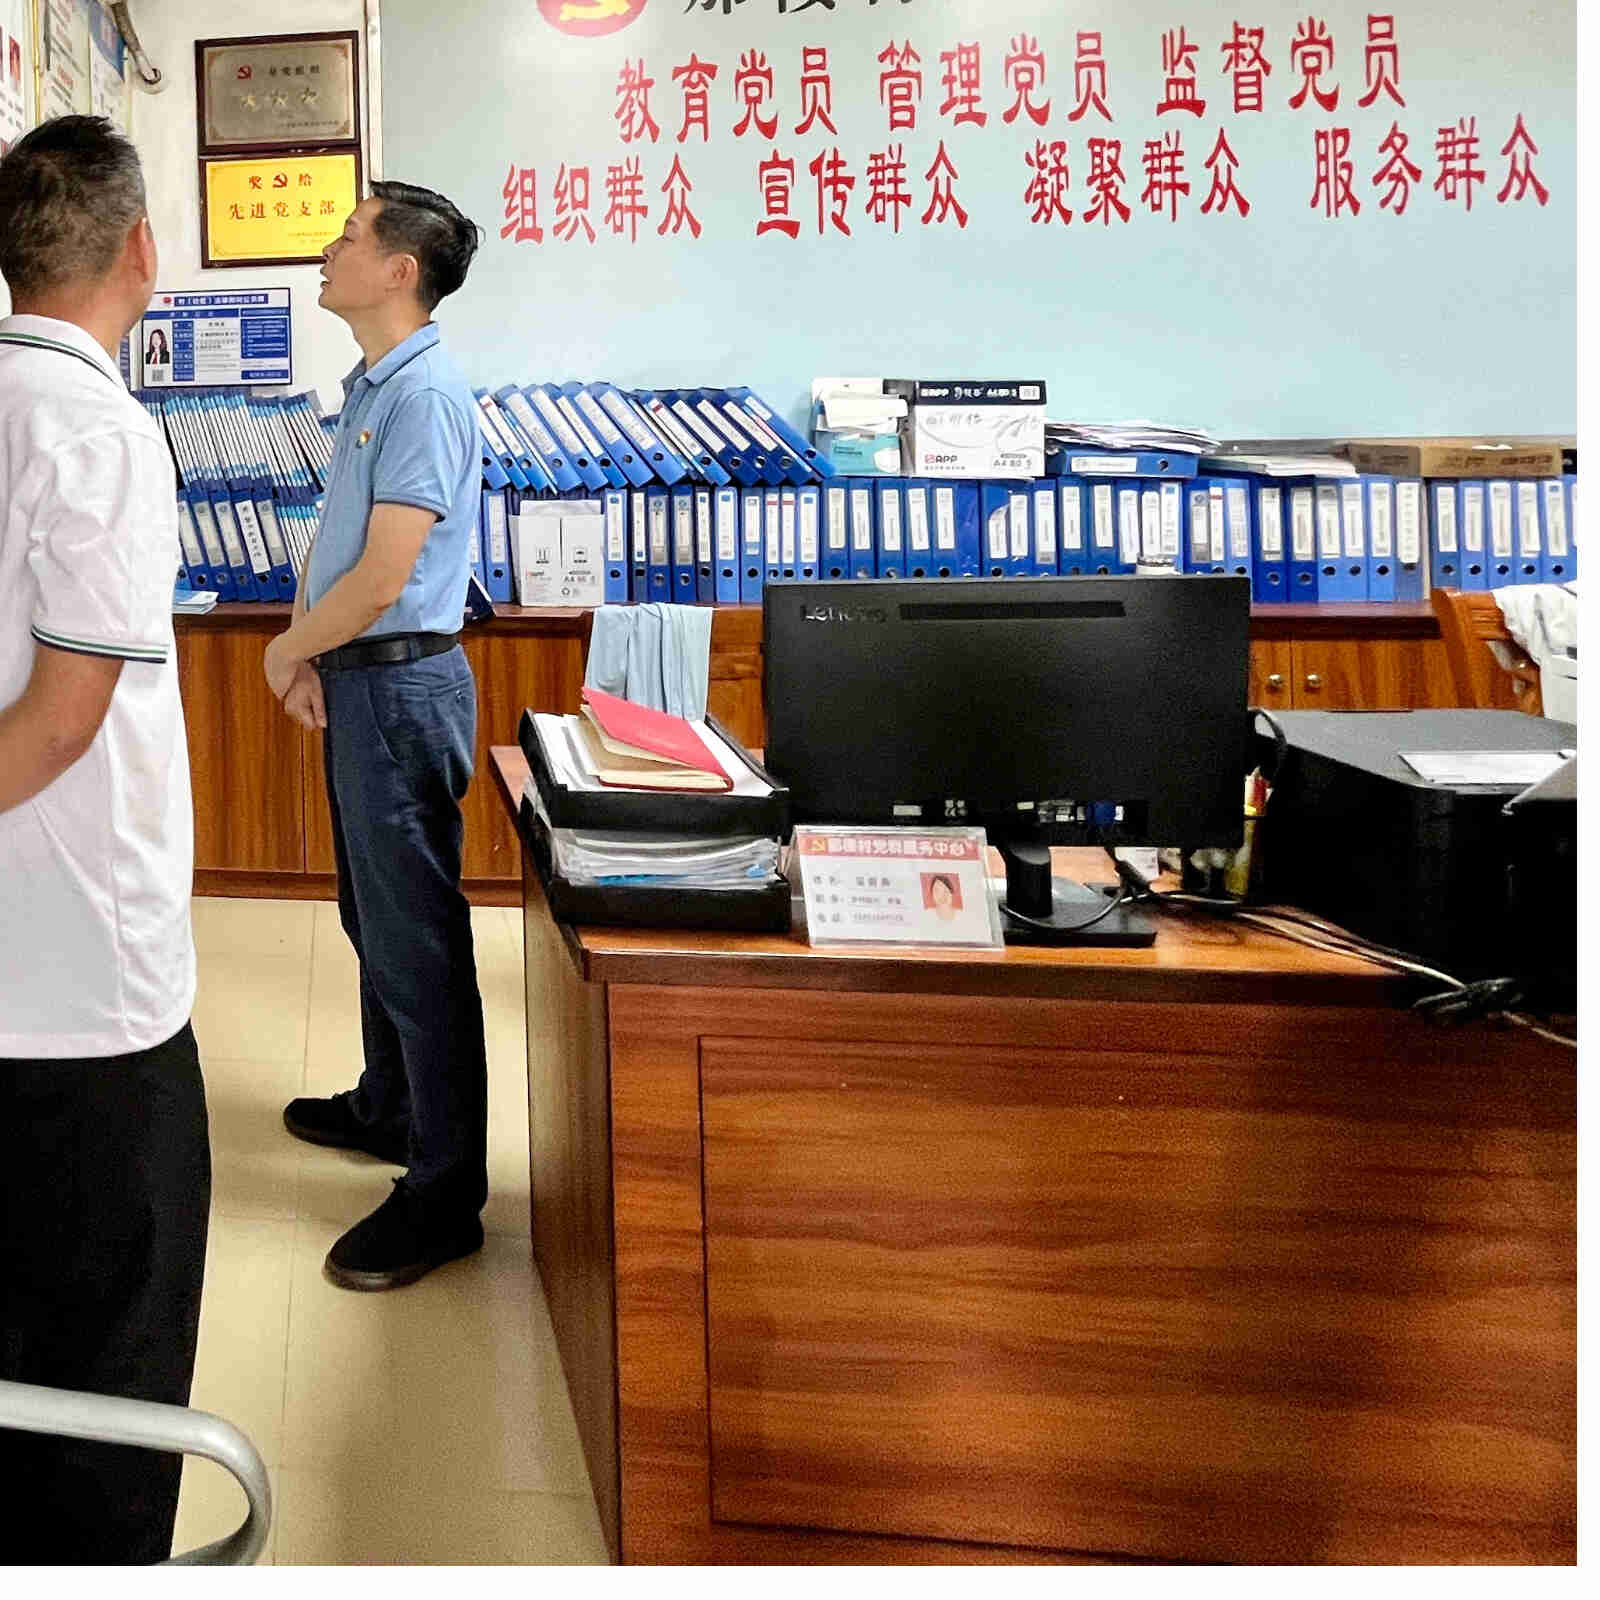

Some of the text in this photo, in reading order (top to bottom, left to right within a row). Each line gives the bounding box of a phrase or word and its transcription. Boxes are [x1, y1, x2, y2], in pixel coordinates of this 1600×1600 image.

[613, 13, 1407, 144] 教育党员 管理党员 监督党员
[228, 200, 336, 221] 先进党支部
[499, 112, 1550, 244] 组织群众 宣传群众 凝聚群众 服务群众
